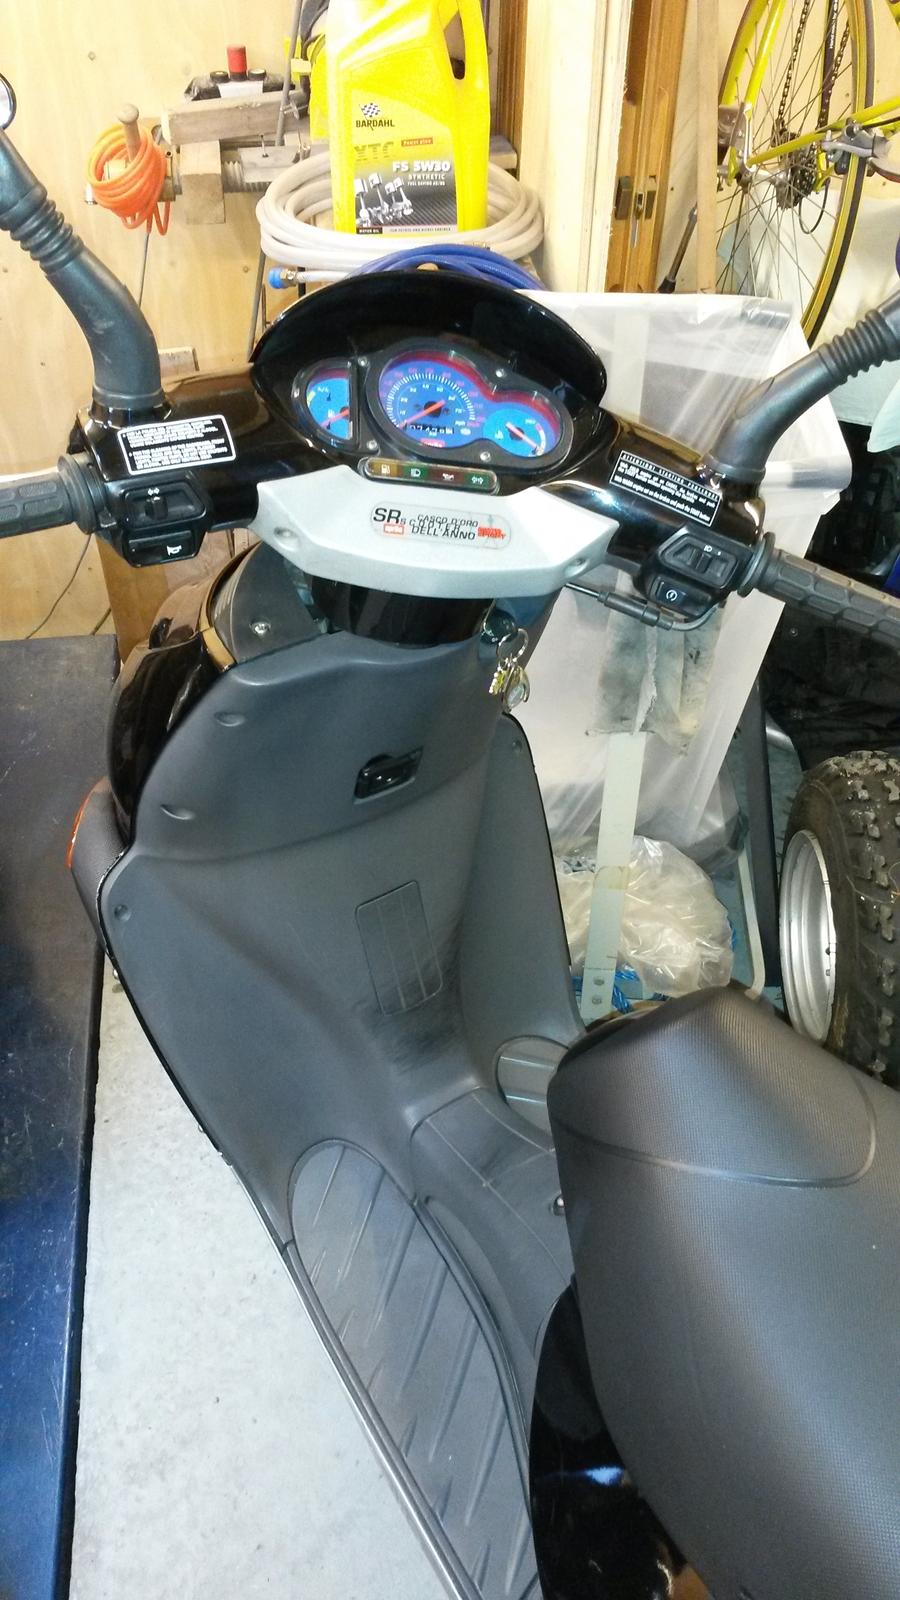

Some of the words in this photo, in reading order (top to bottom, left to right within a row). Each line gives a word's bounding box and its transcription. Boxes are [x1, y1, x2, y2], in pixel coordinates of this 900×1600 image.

[356, 119, 395, 129] BARDAHL
[393, 160, 409, 172] FS
[413, 160, 451, 172] 5W30
[373, 507, 401, 524] SR
[417, 513, 448, 524] CASCO
[451, 516, 479, 528] D'ORO
[400, 518, 460, 532] SCOOTER
[412, 525, 476, 540] DELL'ANNO
